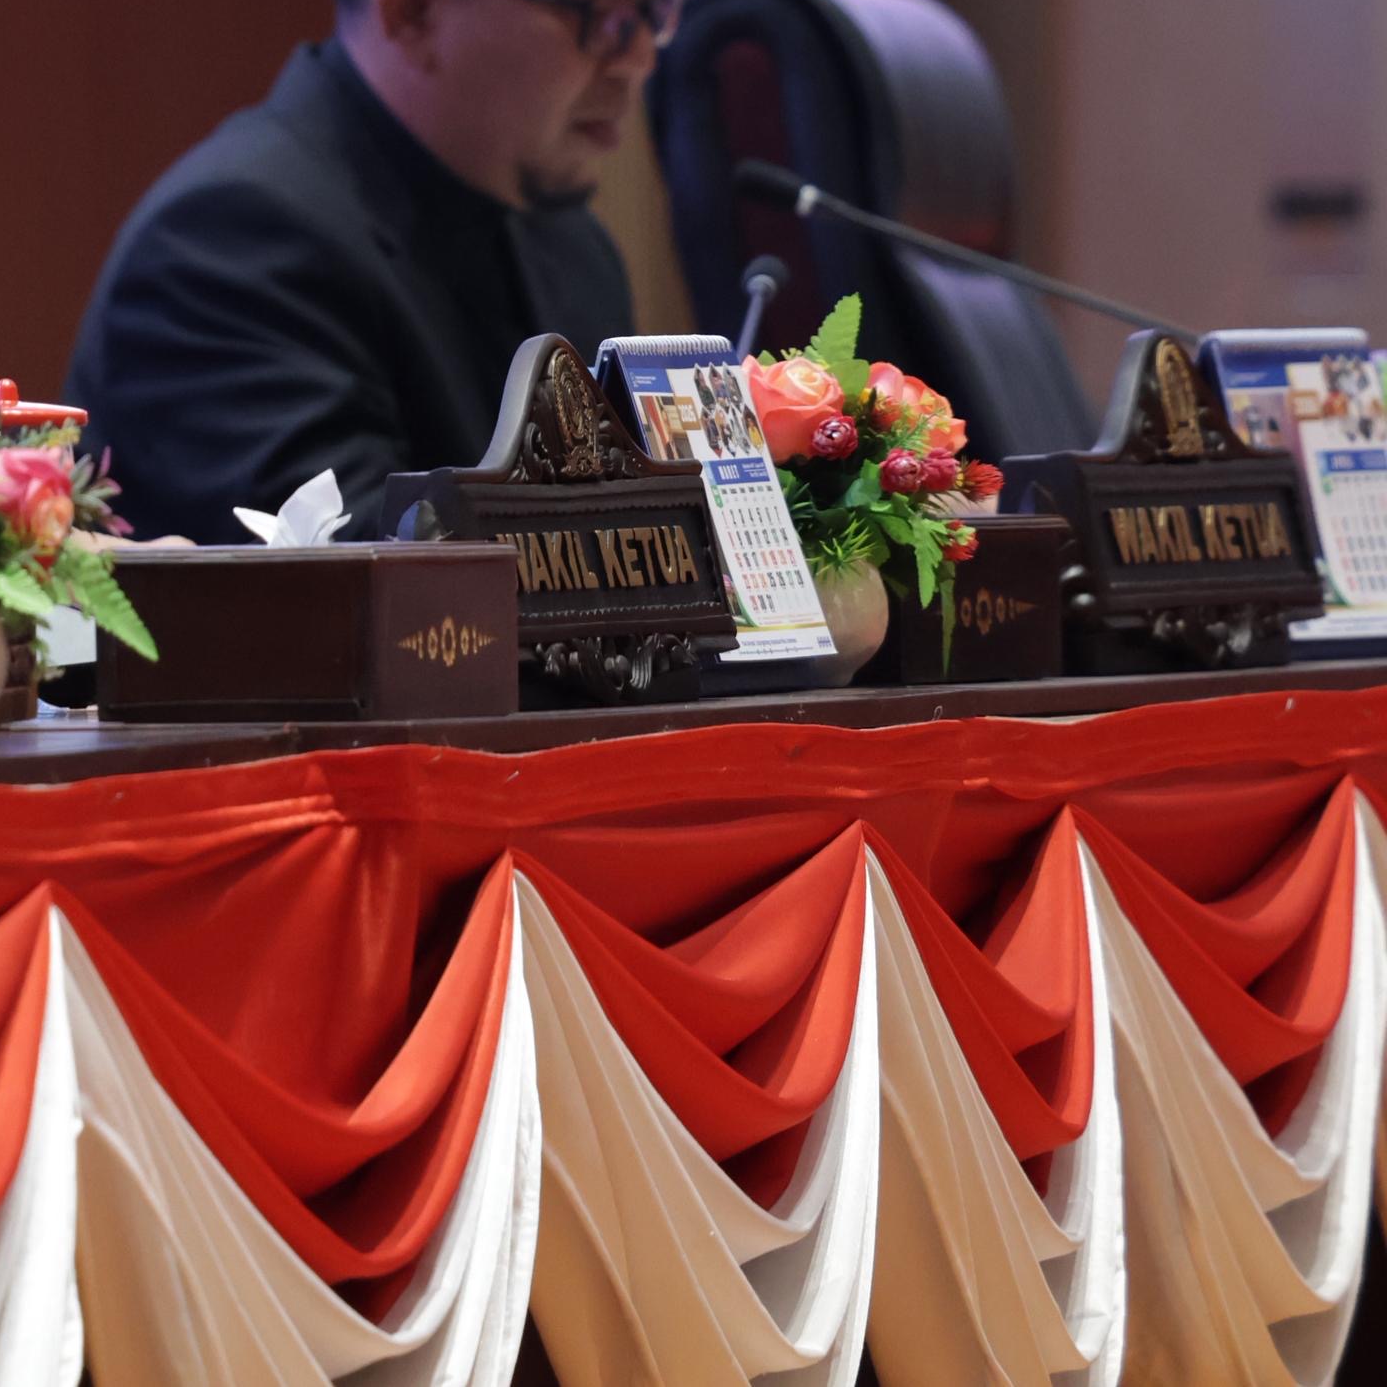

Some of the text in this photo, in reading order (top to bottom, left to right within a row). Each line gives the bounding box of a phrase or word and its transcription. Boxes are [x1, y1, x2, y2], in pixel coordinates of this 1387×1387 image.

[594, 525, 699, 588] KETUA
[1108, 505, 1201, 564] WAKIL
[1198, 502, 1292, 559] KETUA
